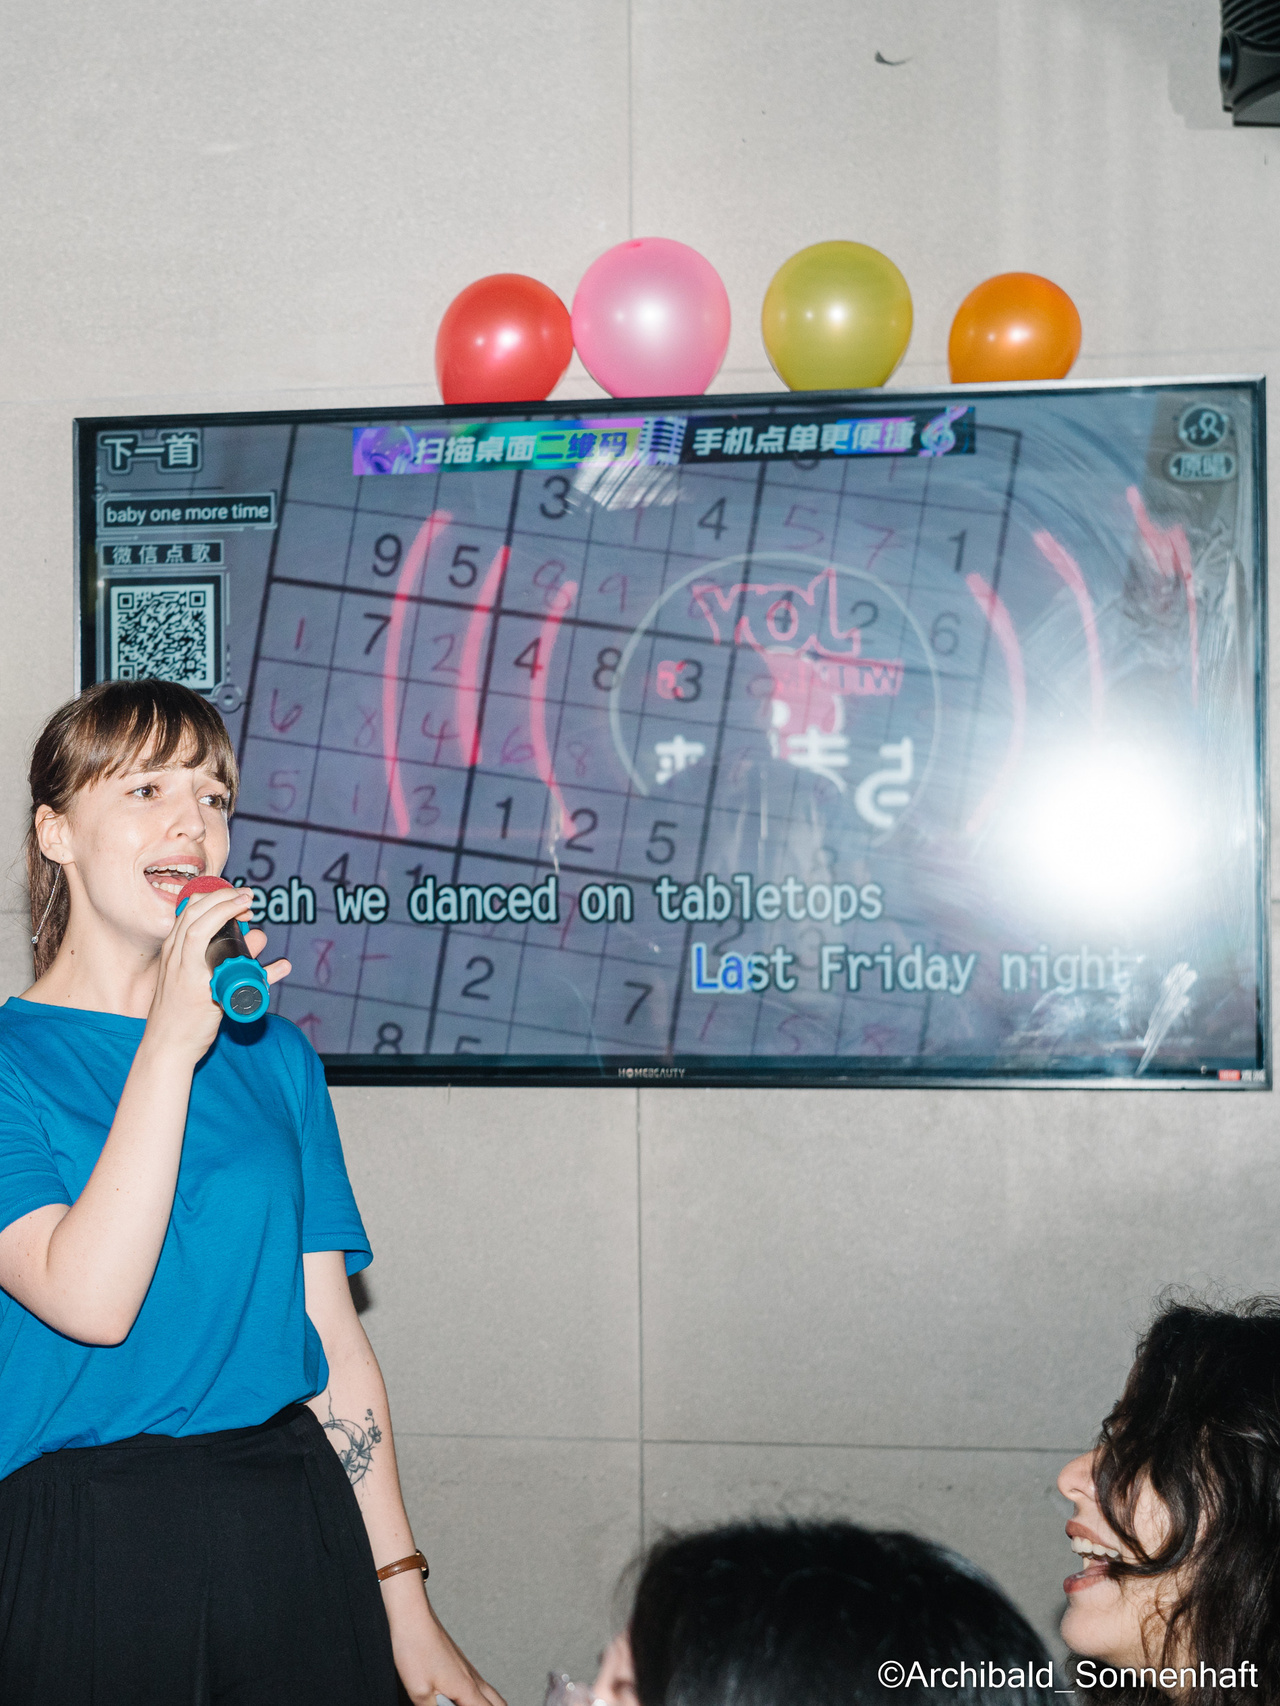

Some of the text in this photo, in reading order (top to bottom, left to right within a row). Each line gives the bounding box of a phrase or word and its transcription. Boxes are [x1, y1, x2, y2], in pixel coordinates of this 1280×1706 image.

[104, 434, 196, 468] 下一首
[413, 431, 628, 464] 扫描桌面二维码
[692, 422, 917, 455] 手机点单更便捷
[106, 502, 269, 526] baby one more time
[539, 475, 570, 520] 3
[697, 497, 728, 541] 4
[949, 528, 968, 573] 1
[112, 543, 211, 565] 微信点歌
[372, 532, 404, 578] 9
[448, 543, 480, 589] 5
[931, 610, 962, 656] 6
[363, 611, 393, 655] 7
[513, 636, 543, 679] 4
[592, 646, 621, 692] 8
[494, 795, 514, 840] 1
[563, 807, 599, 854] 2
[645, 819, 680, 866] 5
[245, 837, 278, 884] 5
[233, 875, 884, 924] eah we danced on tabletops
[461, 955, 656, 1026] 2 7
[691, 942, 1133, 996] Last Friday night
